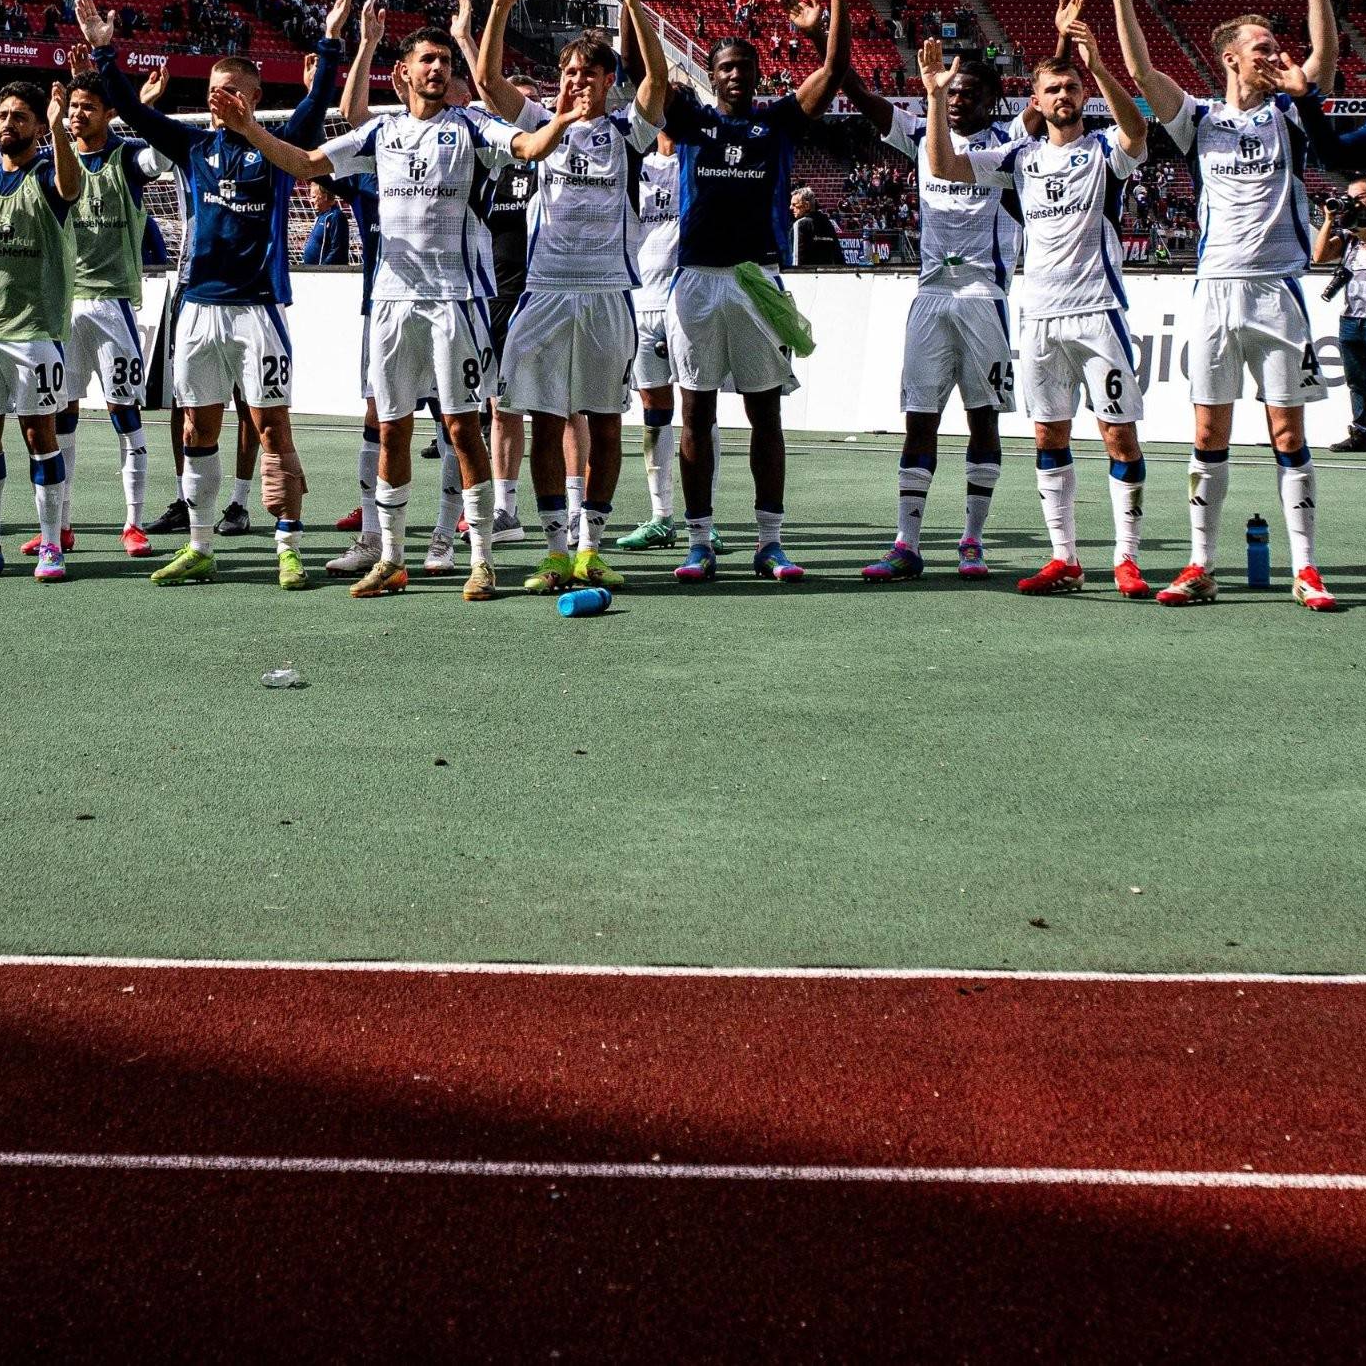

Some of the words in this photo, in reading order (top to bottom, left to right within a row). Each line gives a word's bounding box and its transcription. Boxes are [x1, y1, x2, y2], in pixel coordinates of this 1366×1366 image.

[4, 44, 38, 55] Brucker
[138, 53, 167, 67] LOTTO
[544, 174, 617, 187] HanseMerkur
[696, 166, 766, 179] HanseMerkur
[382, 185, 458, 198] HanseMerkur
[36, 361, 64, 394] 10
[113, 356, 143, 386] 38
[262, 355, 289, 386] 28
[463, 357, 480, 390] 8
[1105, 368, 1123, 401] 6
